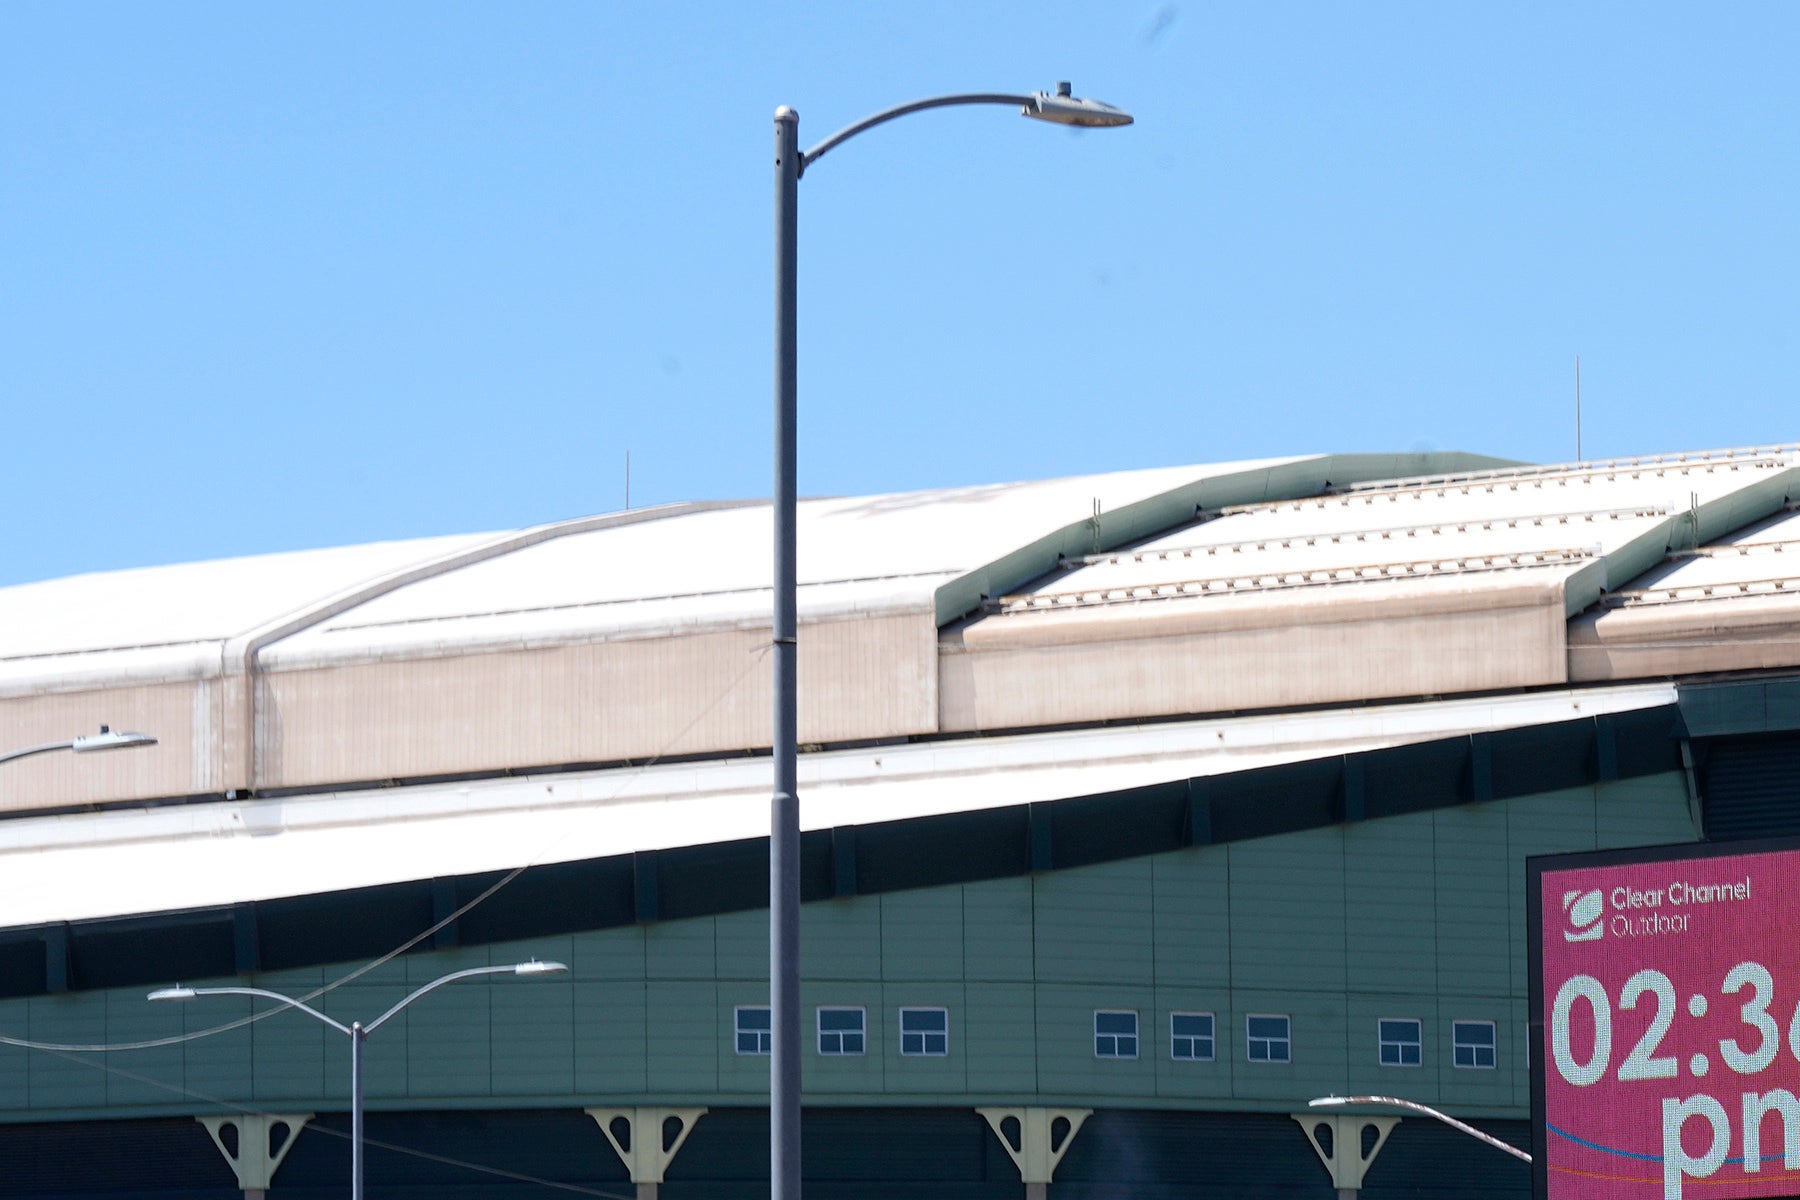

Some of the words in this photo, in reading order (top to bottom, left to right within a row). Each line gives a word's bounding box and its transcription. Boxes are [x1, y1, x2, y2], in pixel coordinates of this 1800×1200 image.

[1611, 883, 1665, 909] Clear
[1669, 876, 1751, 905] Channel
[1611, 911, 1692, 938] Outdoor
